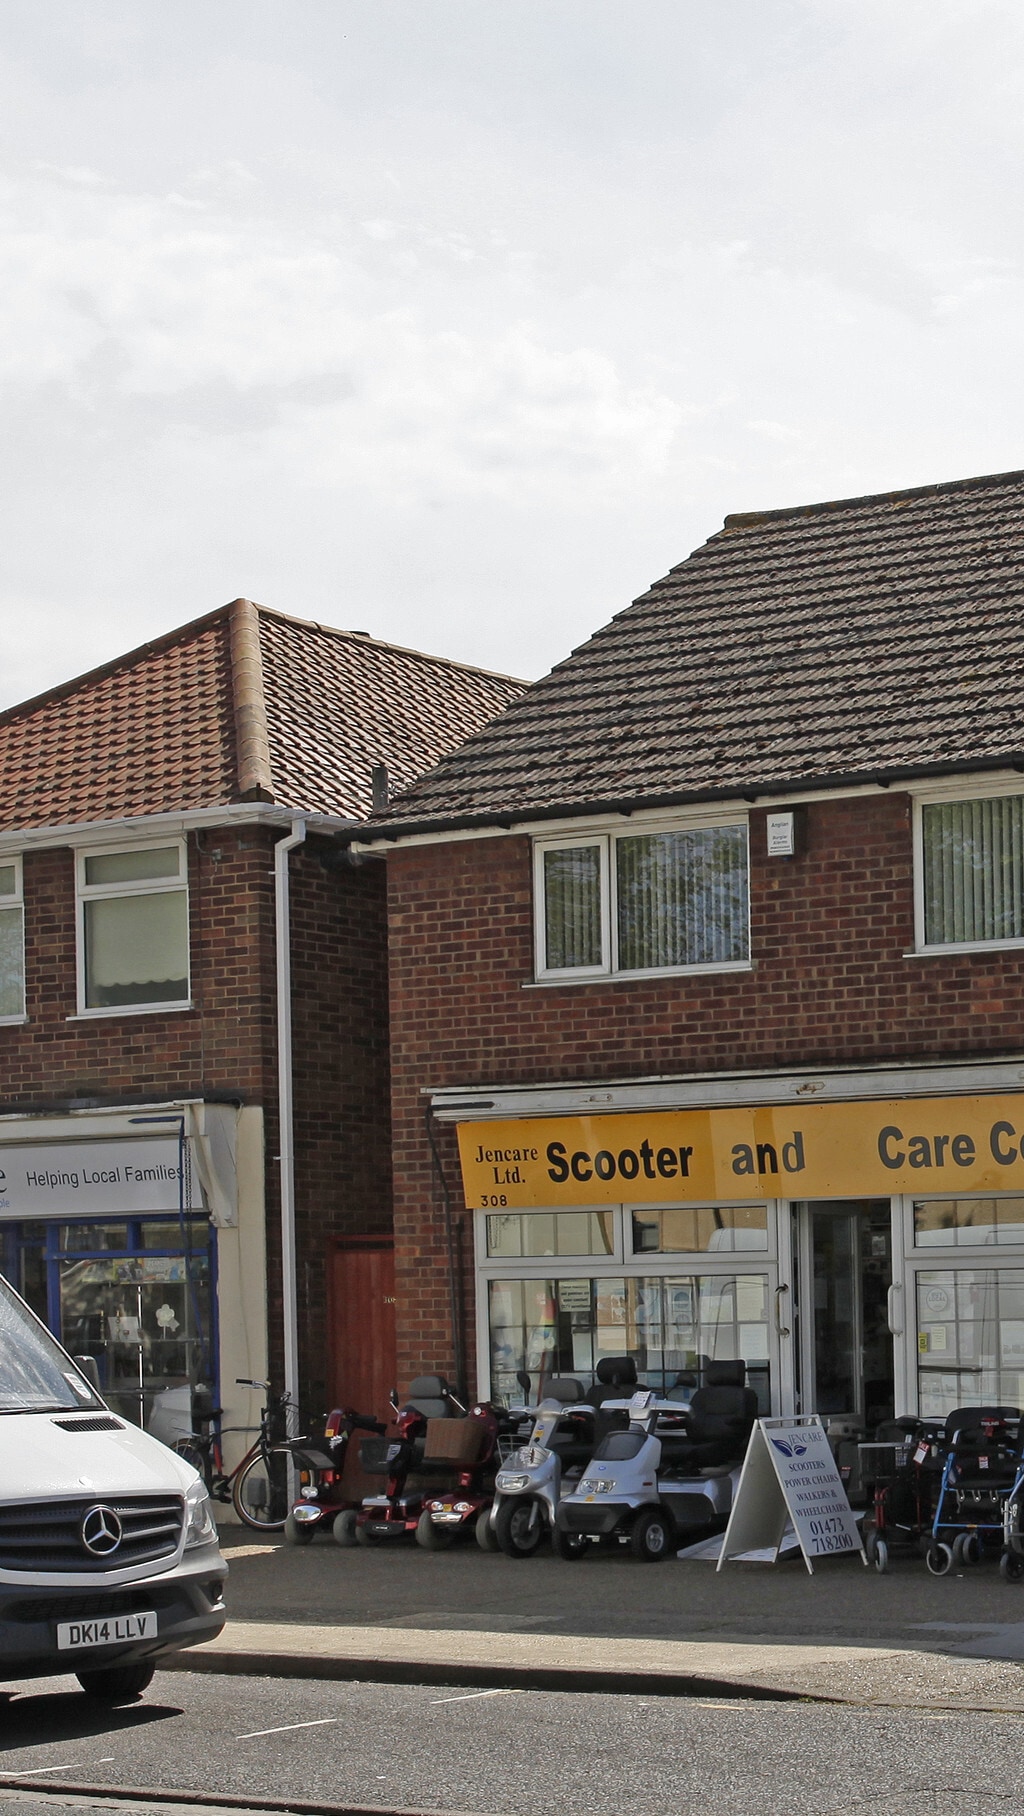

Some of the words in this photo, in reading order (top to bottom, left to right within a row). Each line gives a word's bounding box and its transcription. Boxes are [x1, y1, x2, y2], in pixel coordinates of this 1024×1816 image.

[475, 1144, 539, 1164] Jencare
[546, 1138, 694, 1183] Scooter
[731, 1131, 806, 1176] and
[877, 1125, 976, 1170] Care
[26, 1169, 79, 1189] Helping
[82, 1167, 121, 1184] Local
[124, 1164, 184, 1182] Families
[493, 1166, 526, 1185] Ltd.
[480, 1194, 508, 1208] 308
[788, 1431, 824, 1447] JENCARE
[788, 1460, 826, 1473] SCOOTERS
[784, 1476, 811, 1489] POWER
[811, 1473, 839, 1486] CHAIRS
[796, 1489, 830, 1501] WALKERS
[830, 1488, 838, 1498] &
[795, 1503, 848, 1517] WHEELCHAIRS
[810, 1517, 844, 1536] 01473
[812, 1533, 853, 1553] 718200
[69, 1623, 110, 1645] DK14
[115, 1617, 146, 1639] LLV
